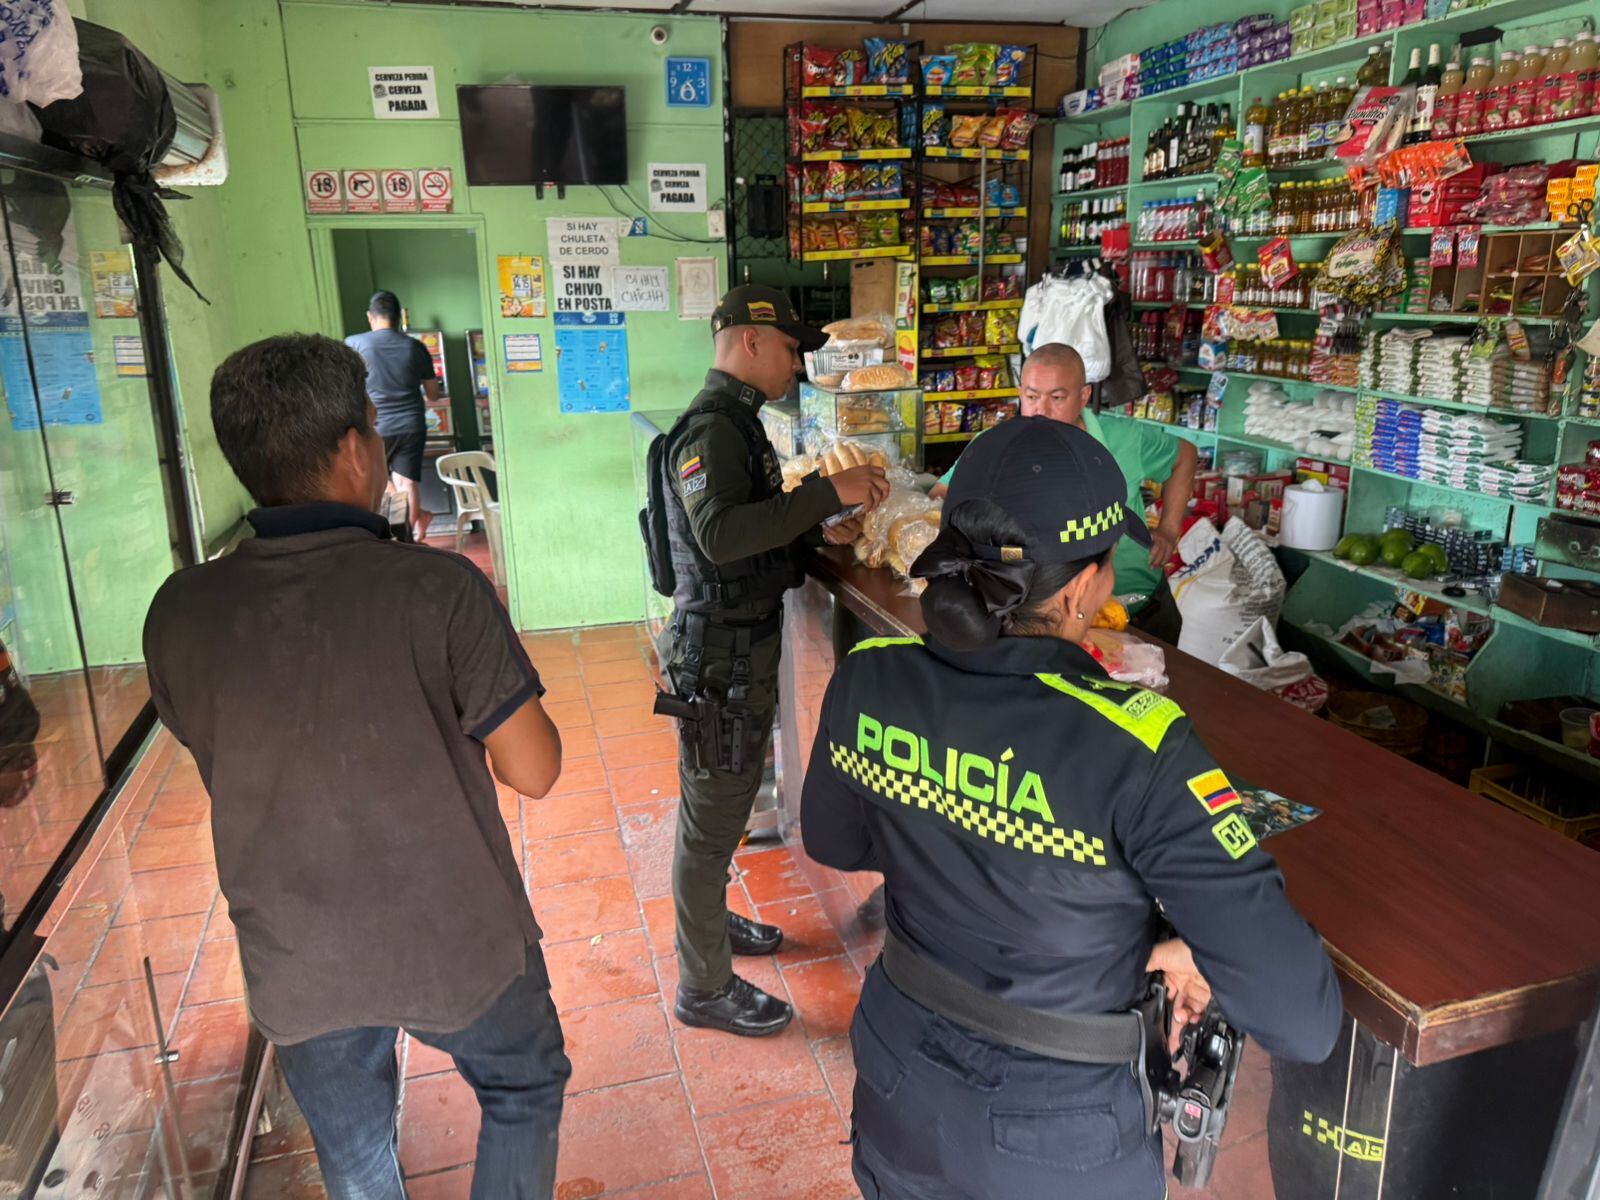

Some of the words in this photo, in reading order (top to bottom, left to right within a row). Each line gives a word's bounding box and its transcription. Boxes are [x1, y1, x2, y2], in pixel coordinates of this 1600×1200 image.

[375, 73, 403, 82] CERVEZA
[404, 72, 428, 81] PEDIDA
[388, 85, 423, 95] CERVEZA
[388, 100, 428, 112] PAGADA
[653, 169, 678, 178] CERVEZA
[315, 177, 333, 193] 18
[391, 176, 408, 192] 18
[664, 180, 690, 188] CERVEZA
[660, 193, 695, 203] PAGADA
[566, 222, 576, 231] SI
[578, 222, 598, 231] HAY
[560, 234, 606, 243] CHULETA
[559, 246, 573, 256] DE
[575, 246, 609, 255] CERDO
[563, 265, 575, 279] SI
[578, 265, 600, 279] HAY
[565, 282, 603, 296] CHIVO
[557, 297, 572, 311] EN
[574, 297, 613, 311] POSTA
[857, 712, 1055, 823] POLICÍA
